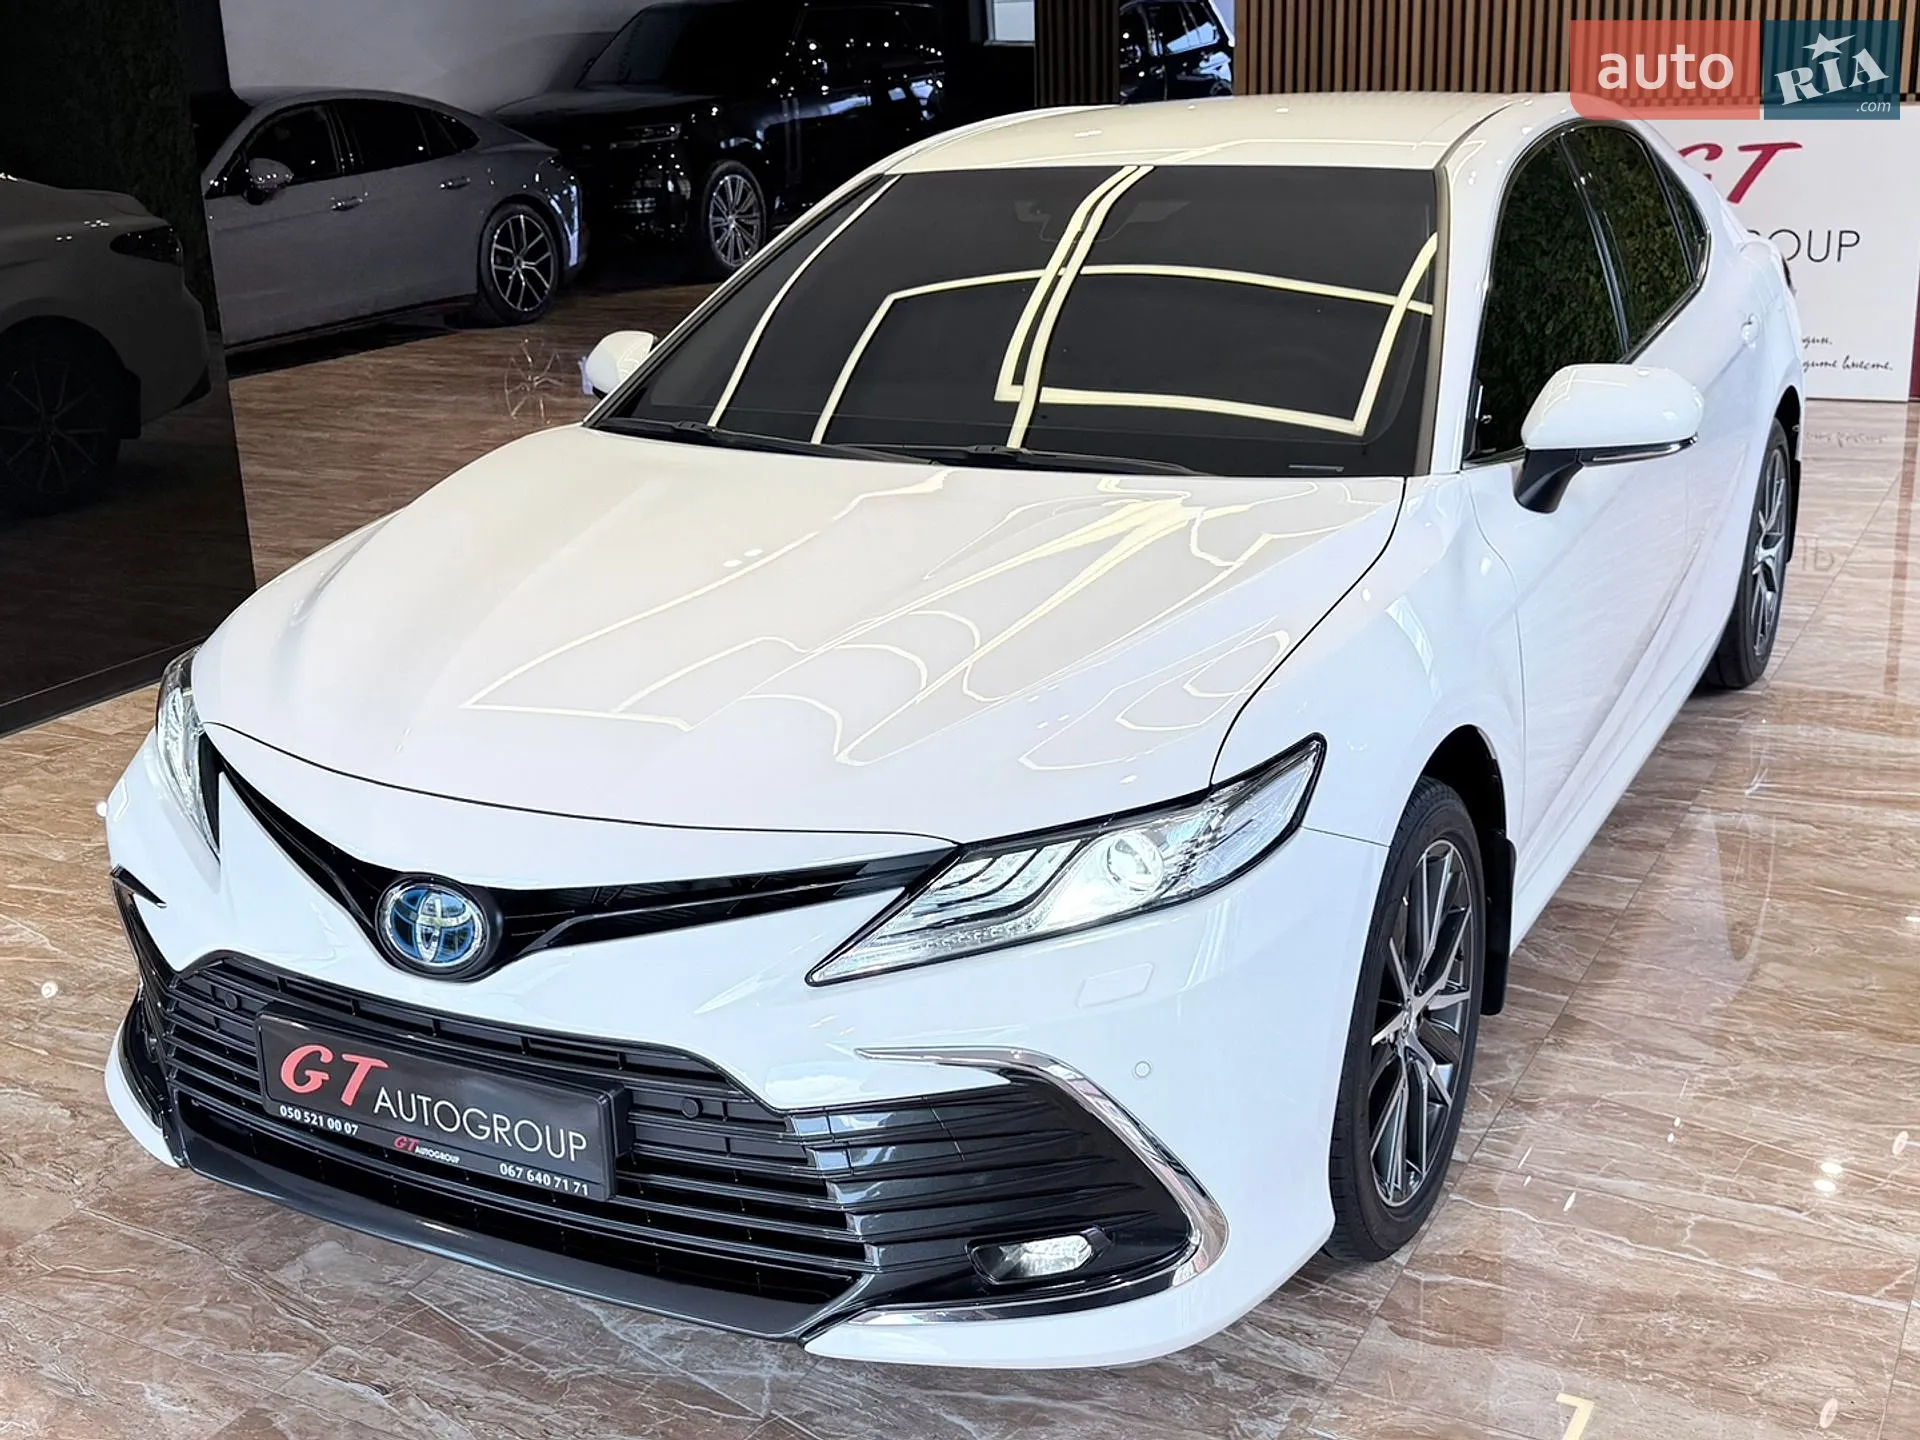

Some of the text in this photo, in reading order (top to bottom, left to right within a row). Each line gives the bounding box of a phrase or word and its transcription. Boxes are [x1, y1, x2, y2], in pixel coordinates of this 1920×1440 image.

[280, 1044, 588, 1162] GT AUTOGROUP
[279, 1105, 359, 1136] 050 521 00 07
[394, 1136, 421, 1153] GT
[499, 1163, 589, 1197] 067 640 71 71
